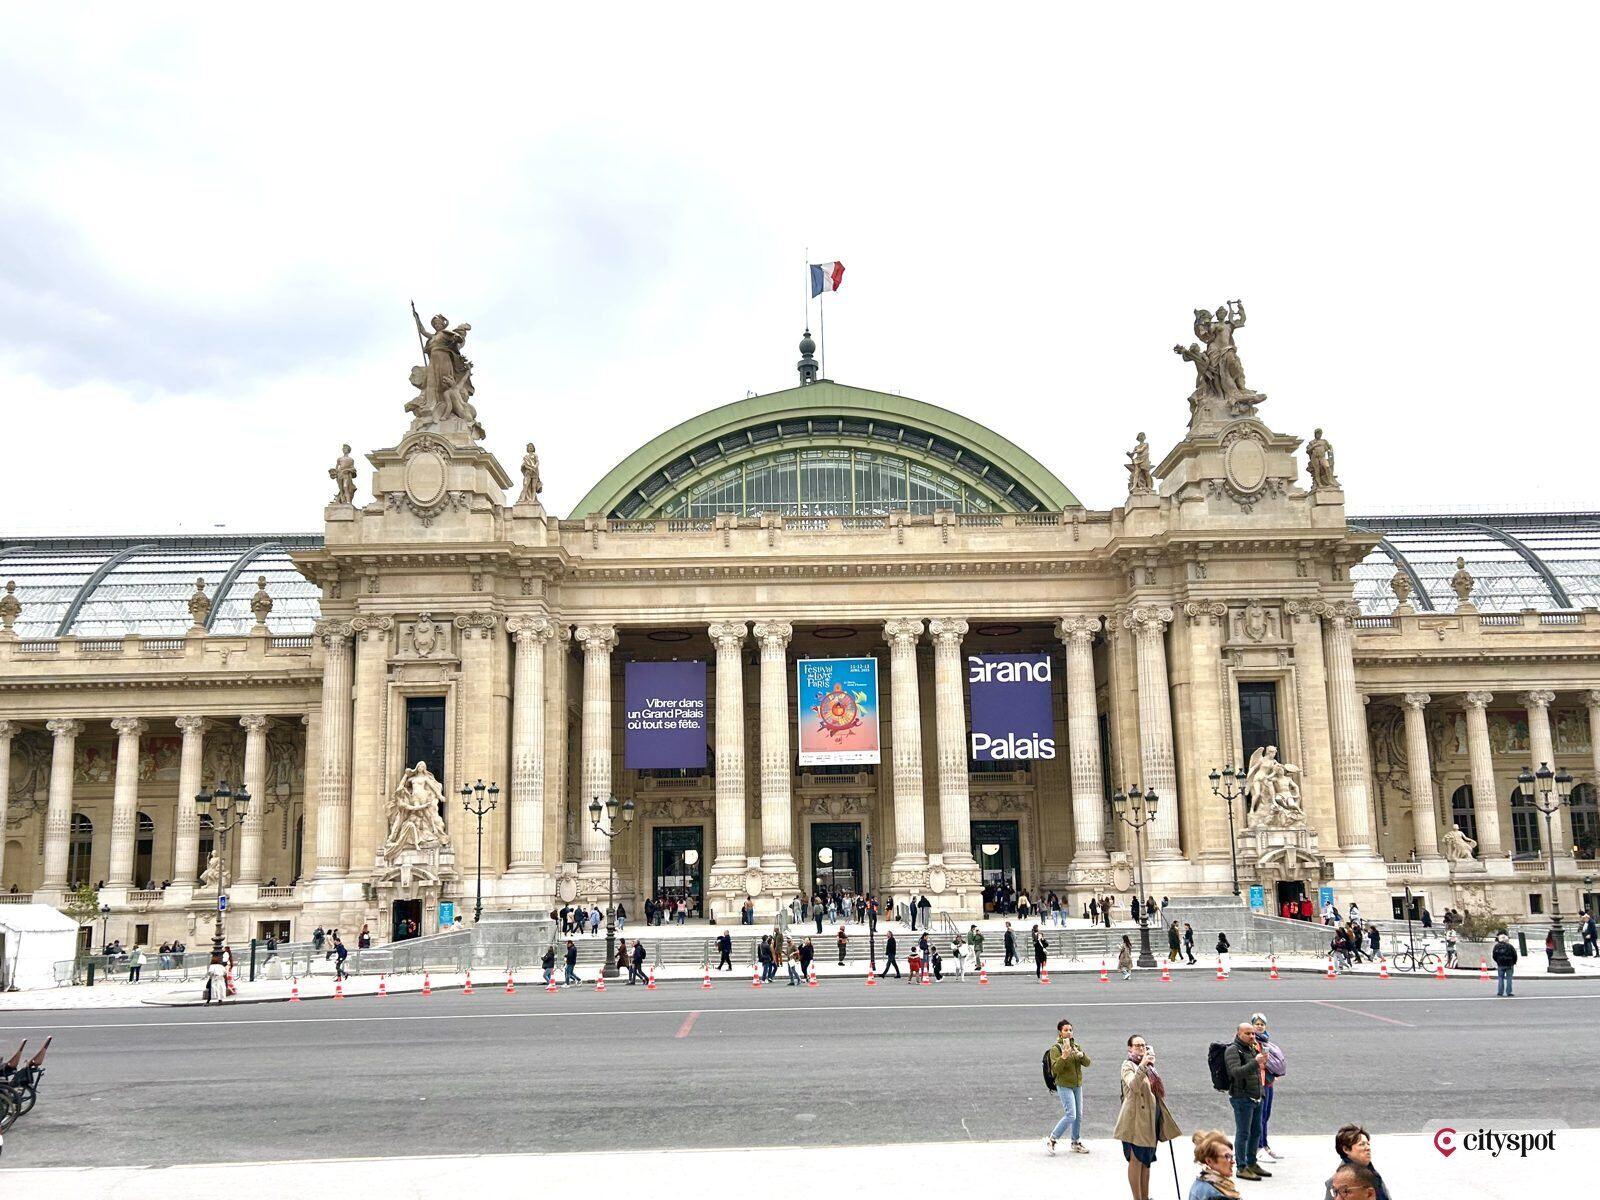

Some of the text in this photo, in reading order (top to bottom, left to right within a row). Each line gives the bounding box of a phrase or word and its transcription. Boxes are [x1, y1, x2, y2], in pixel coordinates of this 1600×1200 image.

[968, 656, 1052, 682] Grand
[646, 698, 703, 708] Vibrer dans
[642, 709, 674, 718] Grand
[675, 709, 703, 718] Palais
[628, 720, 641, 729] où
[643, 720, 663, 729] tout
[678, 720, 700, 729] fête.
[972, 732, 1056, 759] Palais
